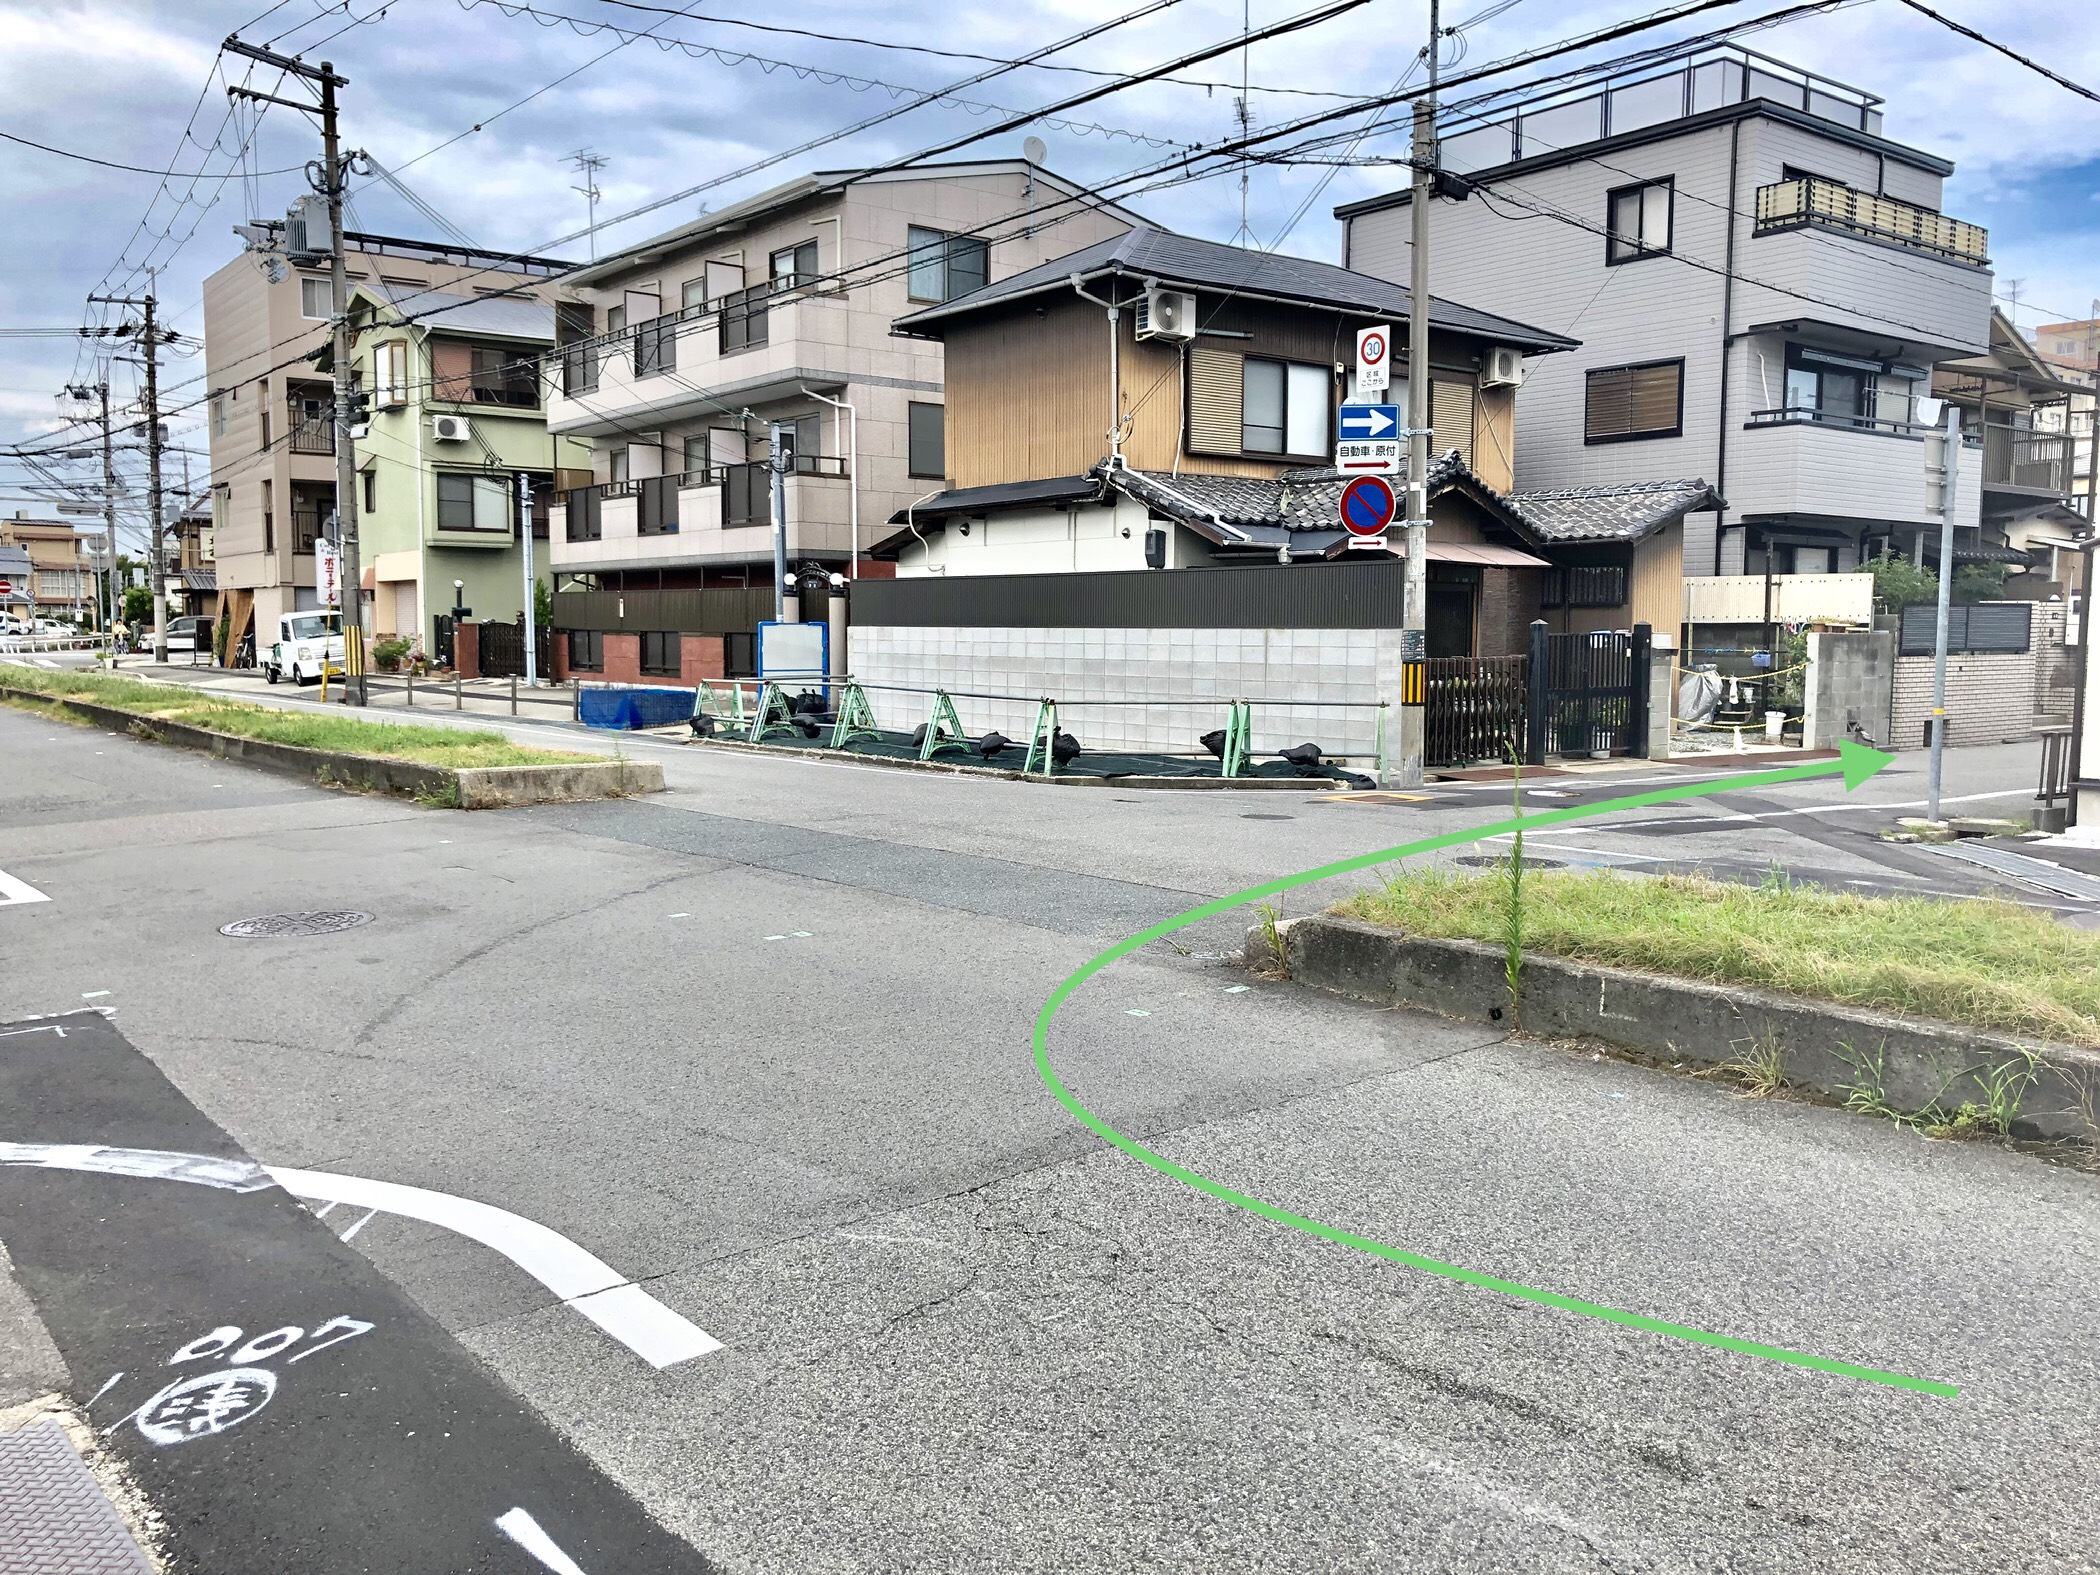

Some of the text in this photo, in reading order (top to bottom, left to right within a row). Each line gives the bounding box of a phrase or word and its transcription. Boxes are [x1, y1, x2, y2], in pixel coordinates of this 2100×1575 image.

[1366, 341, 1380, 356] 30
[1361, 377, 1384, 387] ここから
